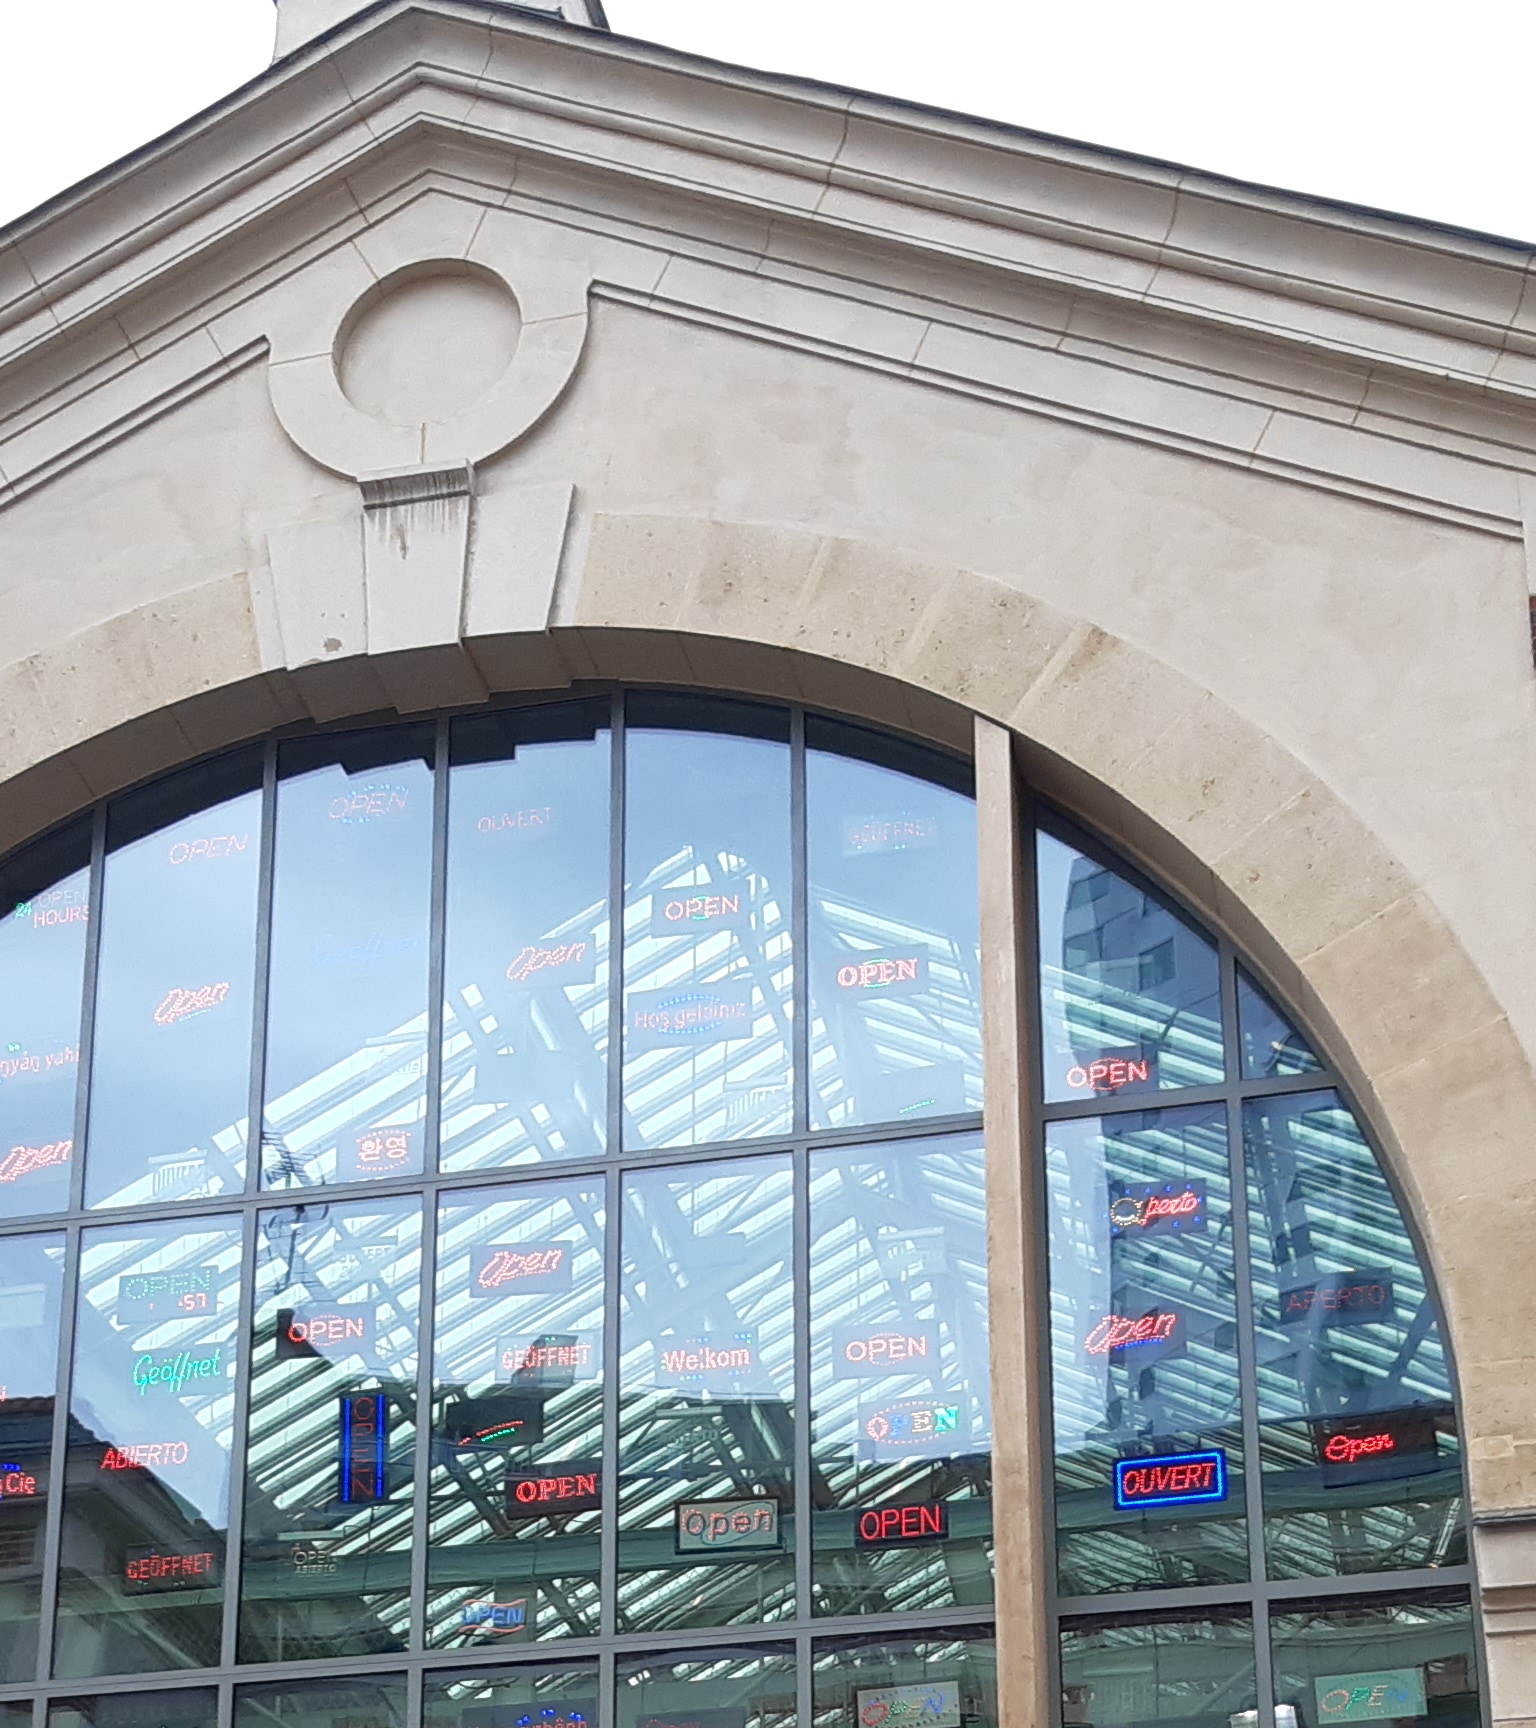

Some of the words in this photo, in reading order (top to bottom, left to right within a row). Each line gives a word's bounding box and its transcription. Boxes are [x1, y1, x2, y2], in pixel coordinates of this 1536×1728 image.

[169, 834, 247, 863] OPEN
[665, 895, 739, 921] OPEN
[838, 958, 916, 987] OPEN
[1066, 1058, 1148, 1089] OPEN
[288, 1315, 363, 1344] OPEN
[1084, 1313, 1175, 1354] Open
[845, 1334, 926, 1362] OPEN
[866, 1405, 958, 1440] OPEN
[100, 1441, 188, 1470] ABIERTO
[514, 1472, 596, 1502] OPEN
[1121, 1462, 1215, 1496] OUVERT
[681, 1508, 773, 1542] Open
[860, 1504, 942, 1540] OPEN
